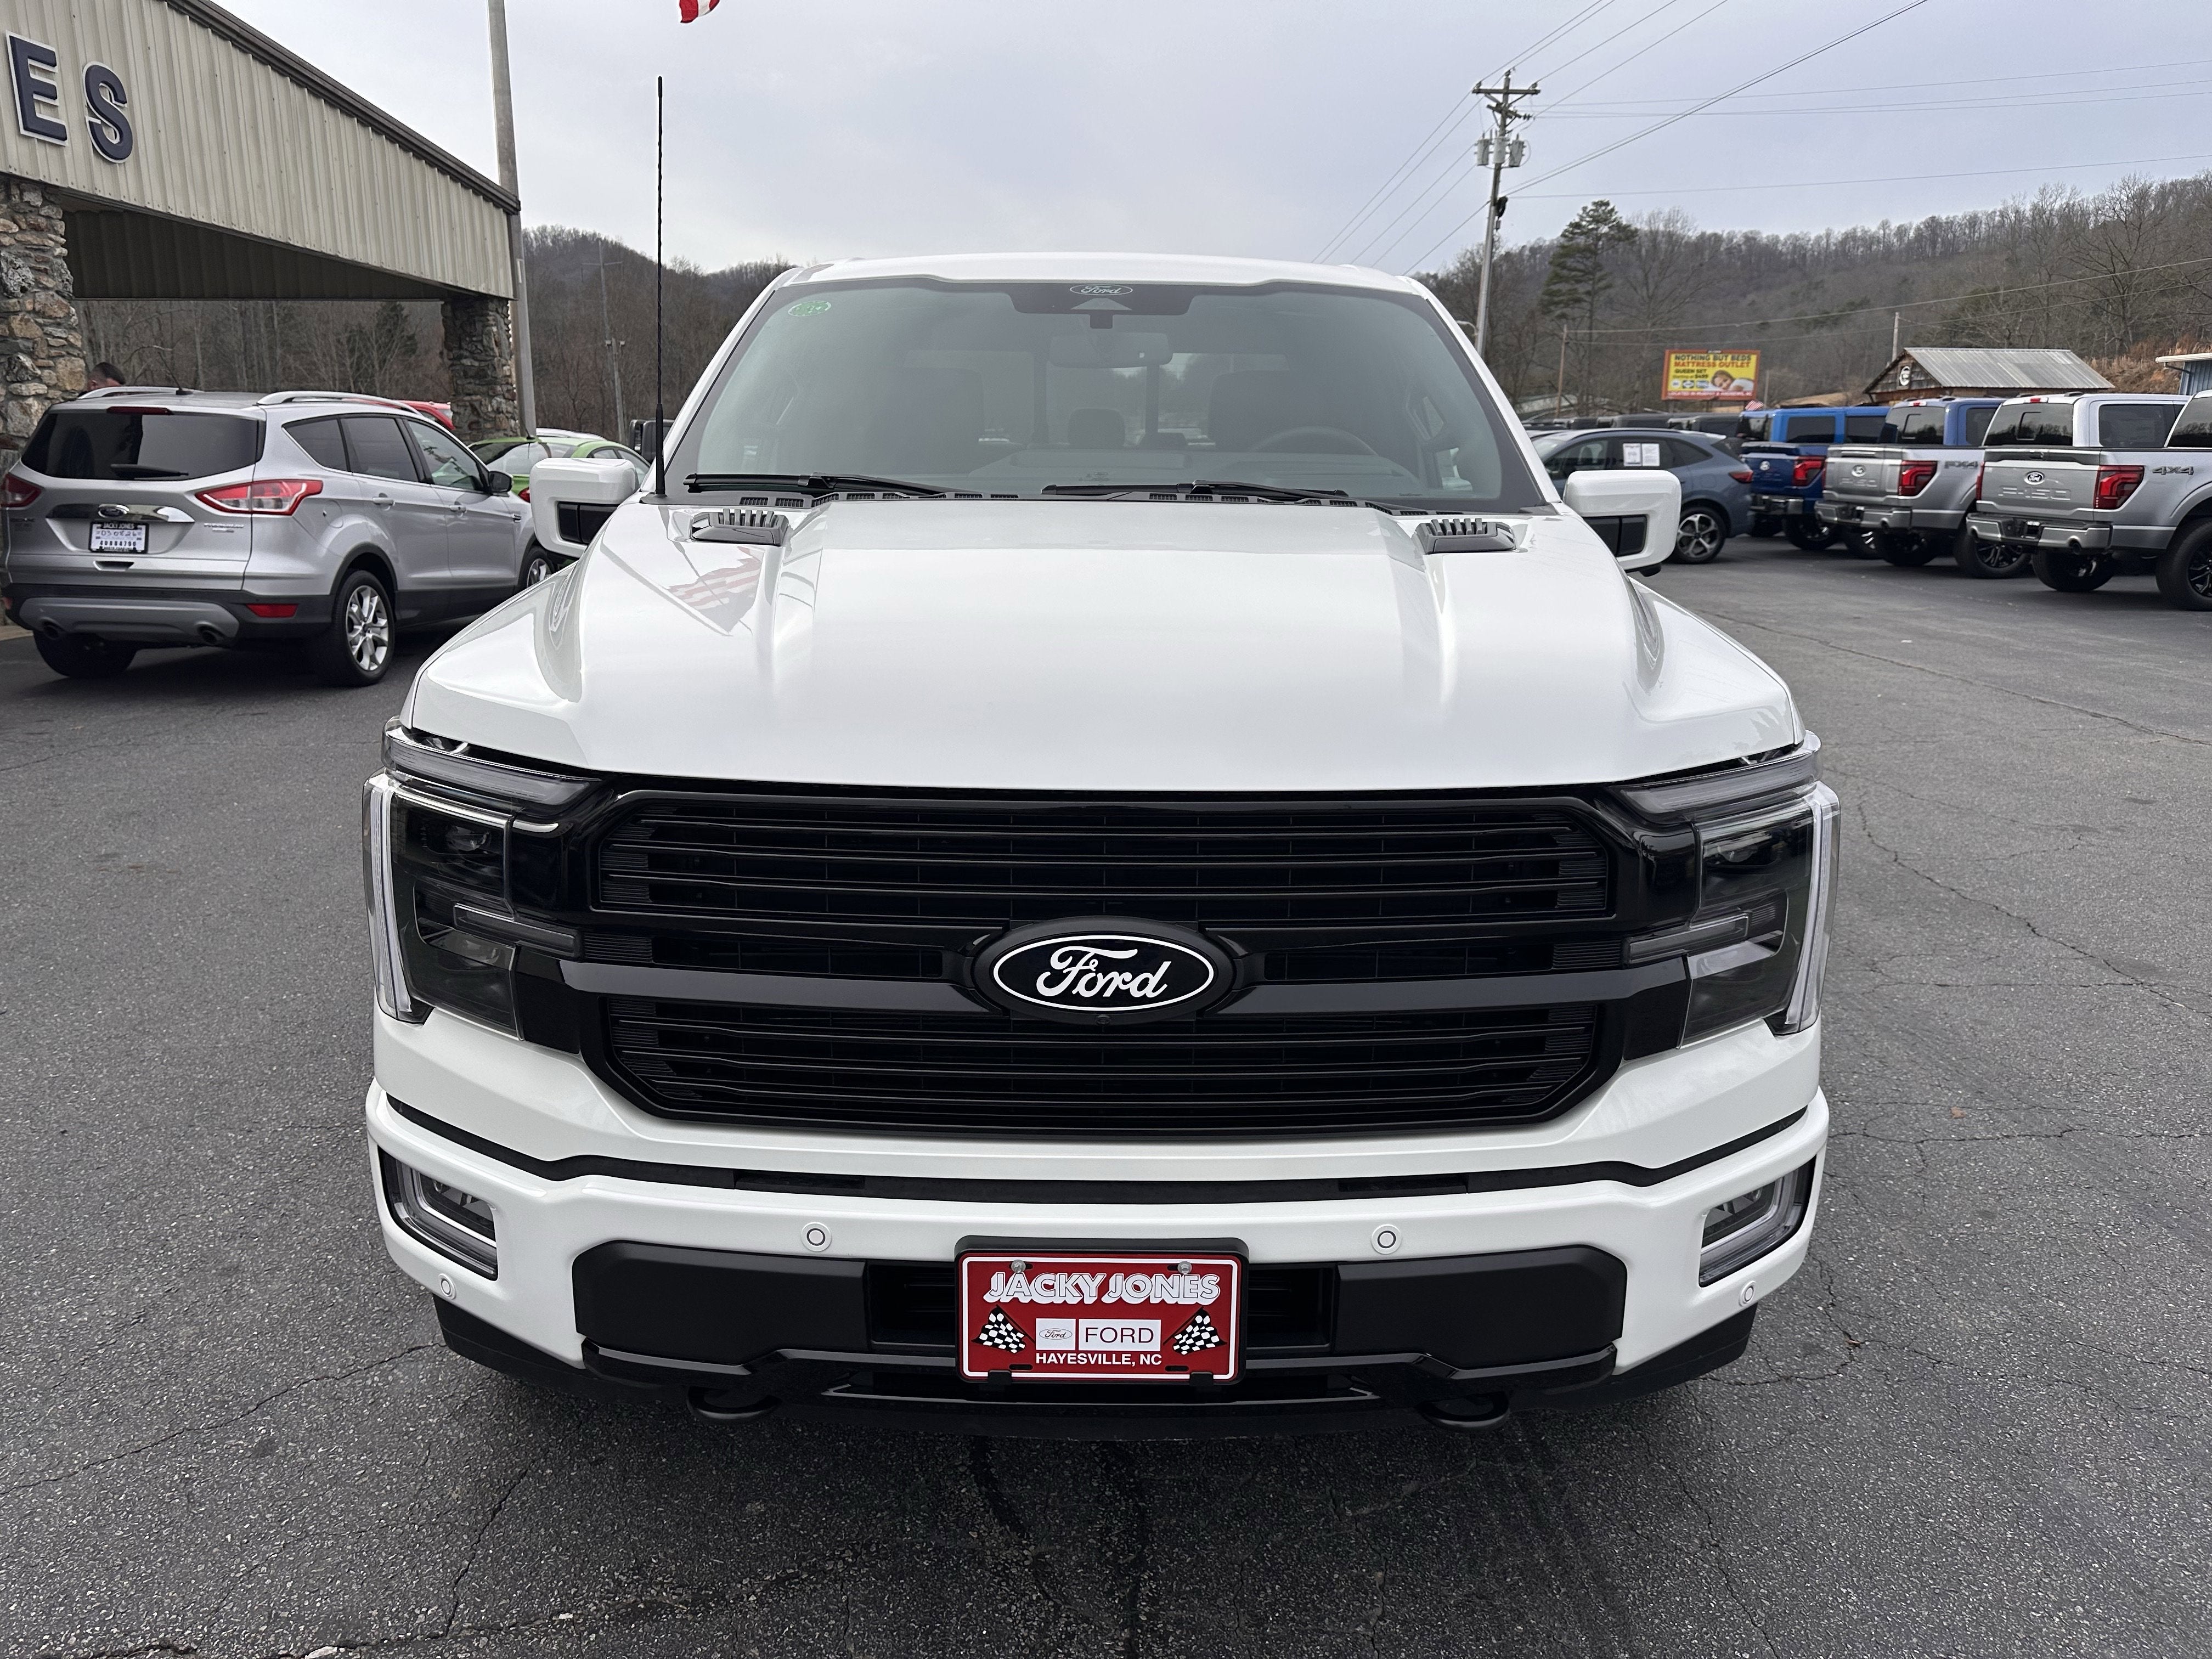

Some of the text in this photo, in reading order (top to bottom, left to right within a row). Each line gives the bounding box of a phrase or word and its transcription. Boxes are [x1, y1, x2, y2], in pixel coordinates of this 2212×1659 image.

[1081, 285, 1121, 294] Ford
[1036, 946, 1171, 997] Ford
[983, 1272, 1221, 1305] JACKY JONES
[1045, 1329, 1066, 1338] Ford
[1085, 1328, 1154, 1343] FORD
[1036, 1353, 1162, 1366] HAYESVILLE, NC
